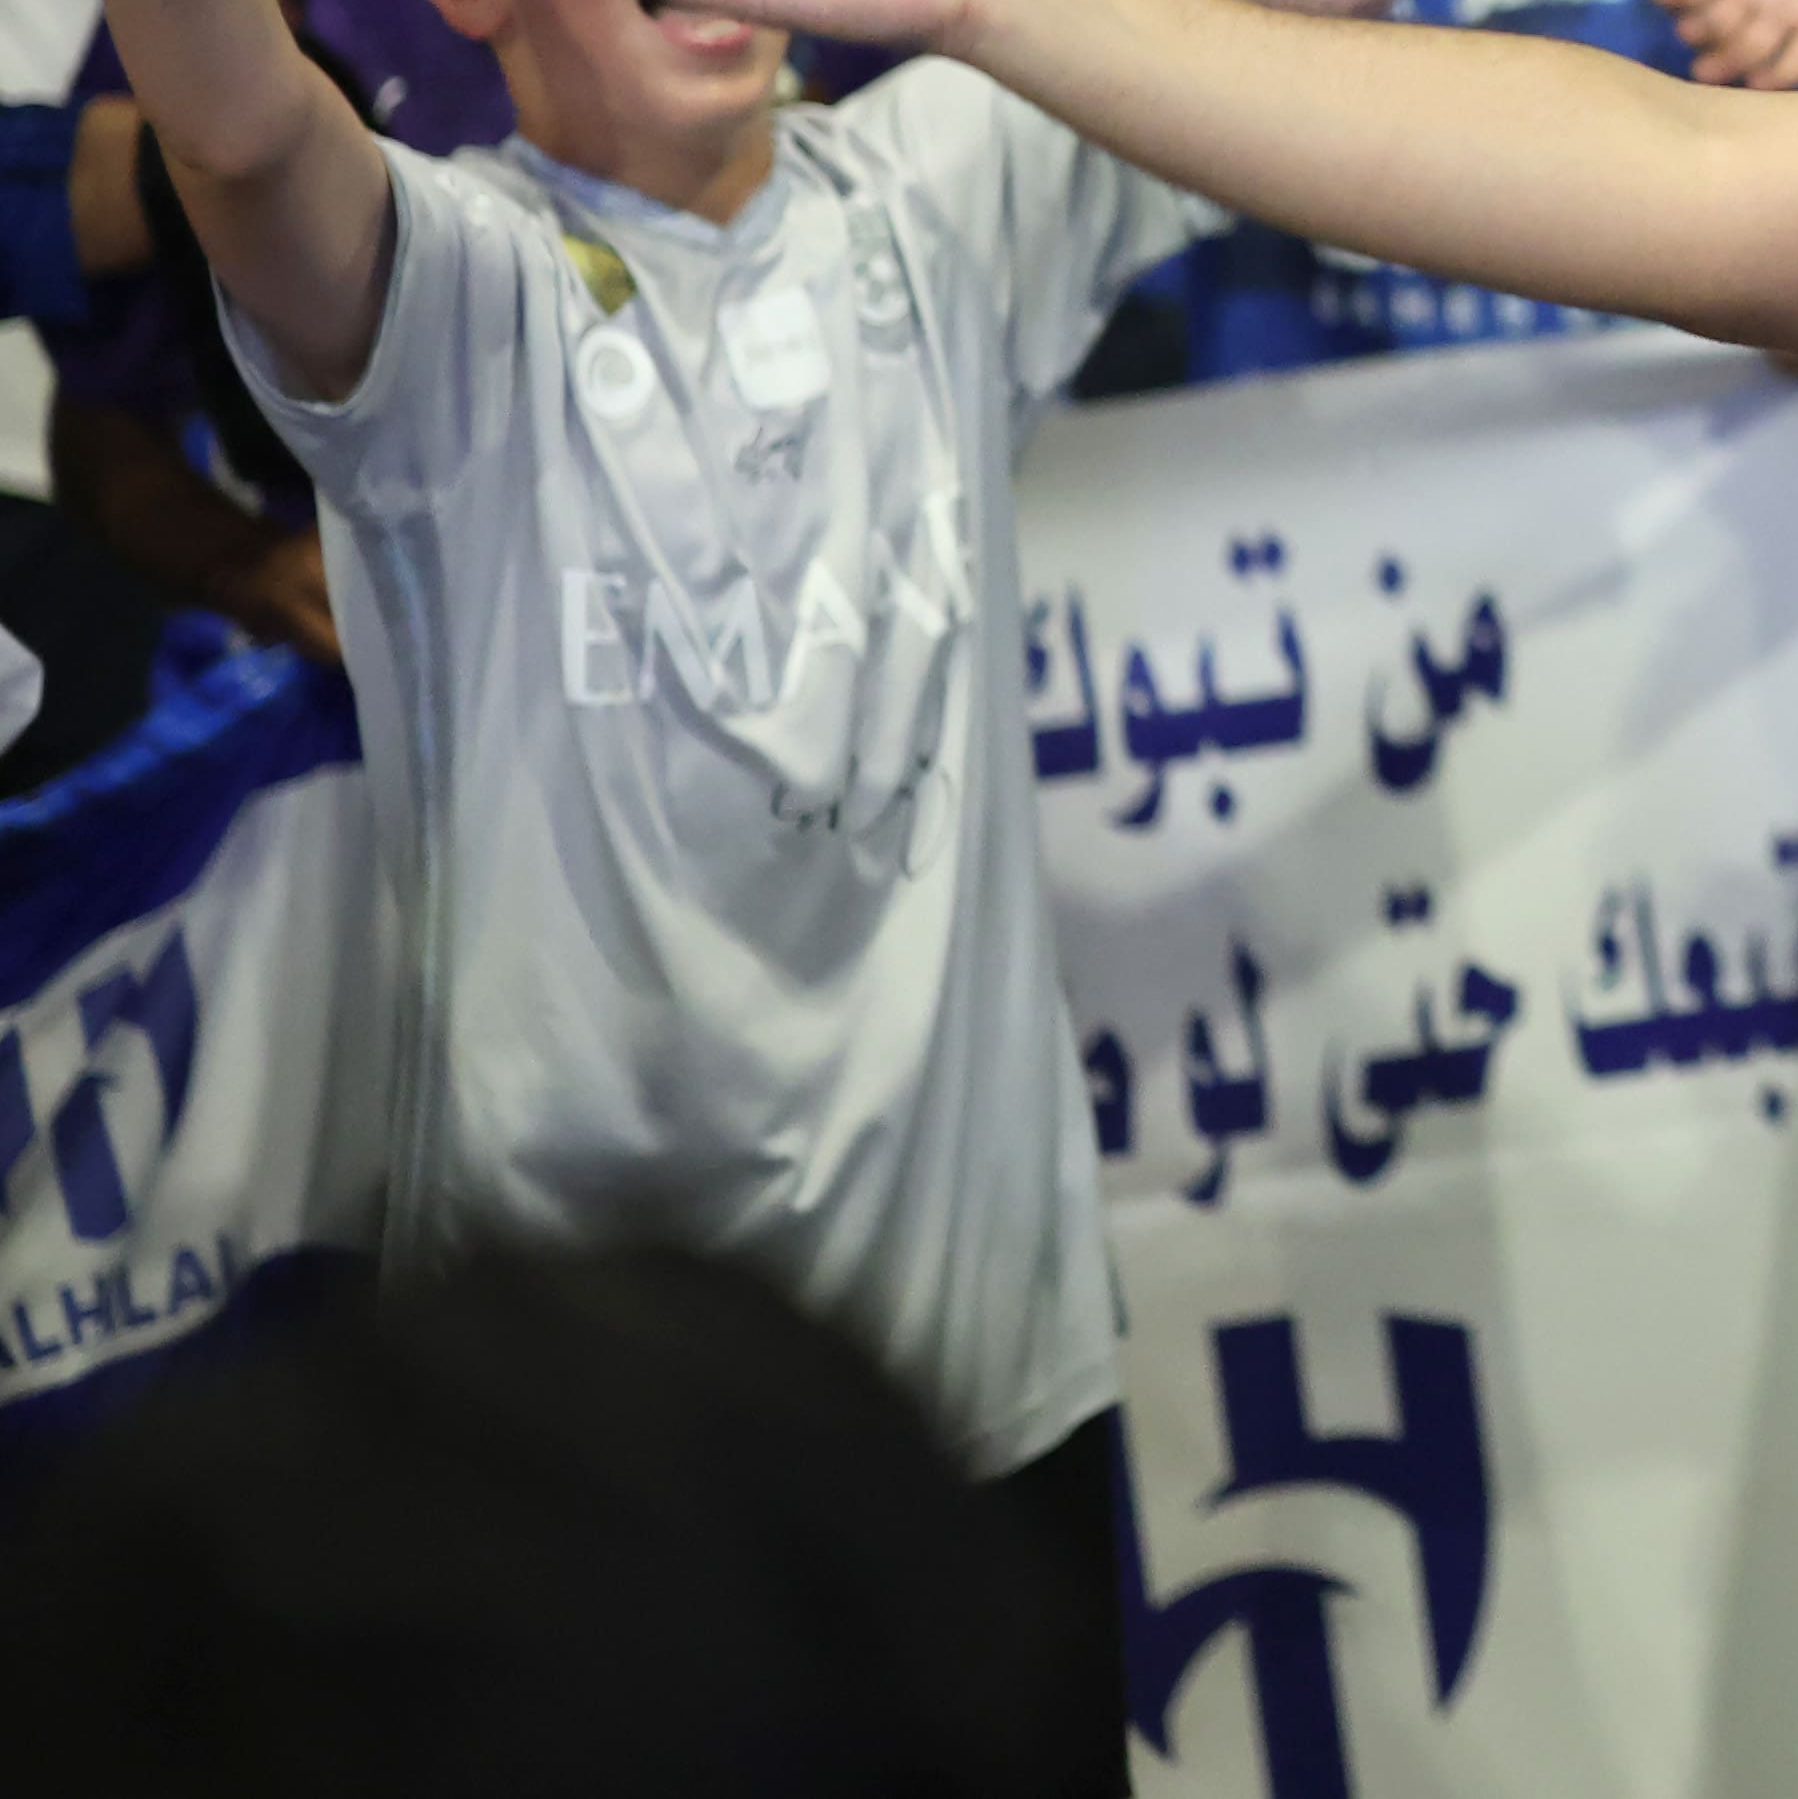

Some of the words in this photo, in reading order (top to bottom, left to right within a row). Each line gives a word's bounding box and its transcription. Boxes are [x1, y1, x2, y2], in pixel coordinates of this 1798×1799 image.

[1023, 529, 1310, 834] تبوك
[1365, 554, 1512, 794] من
[1318, 882, 1524, 1187] حتى
